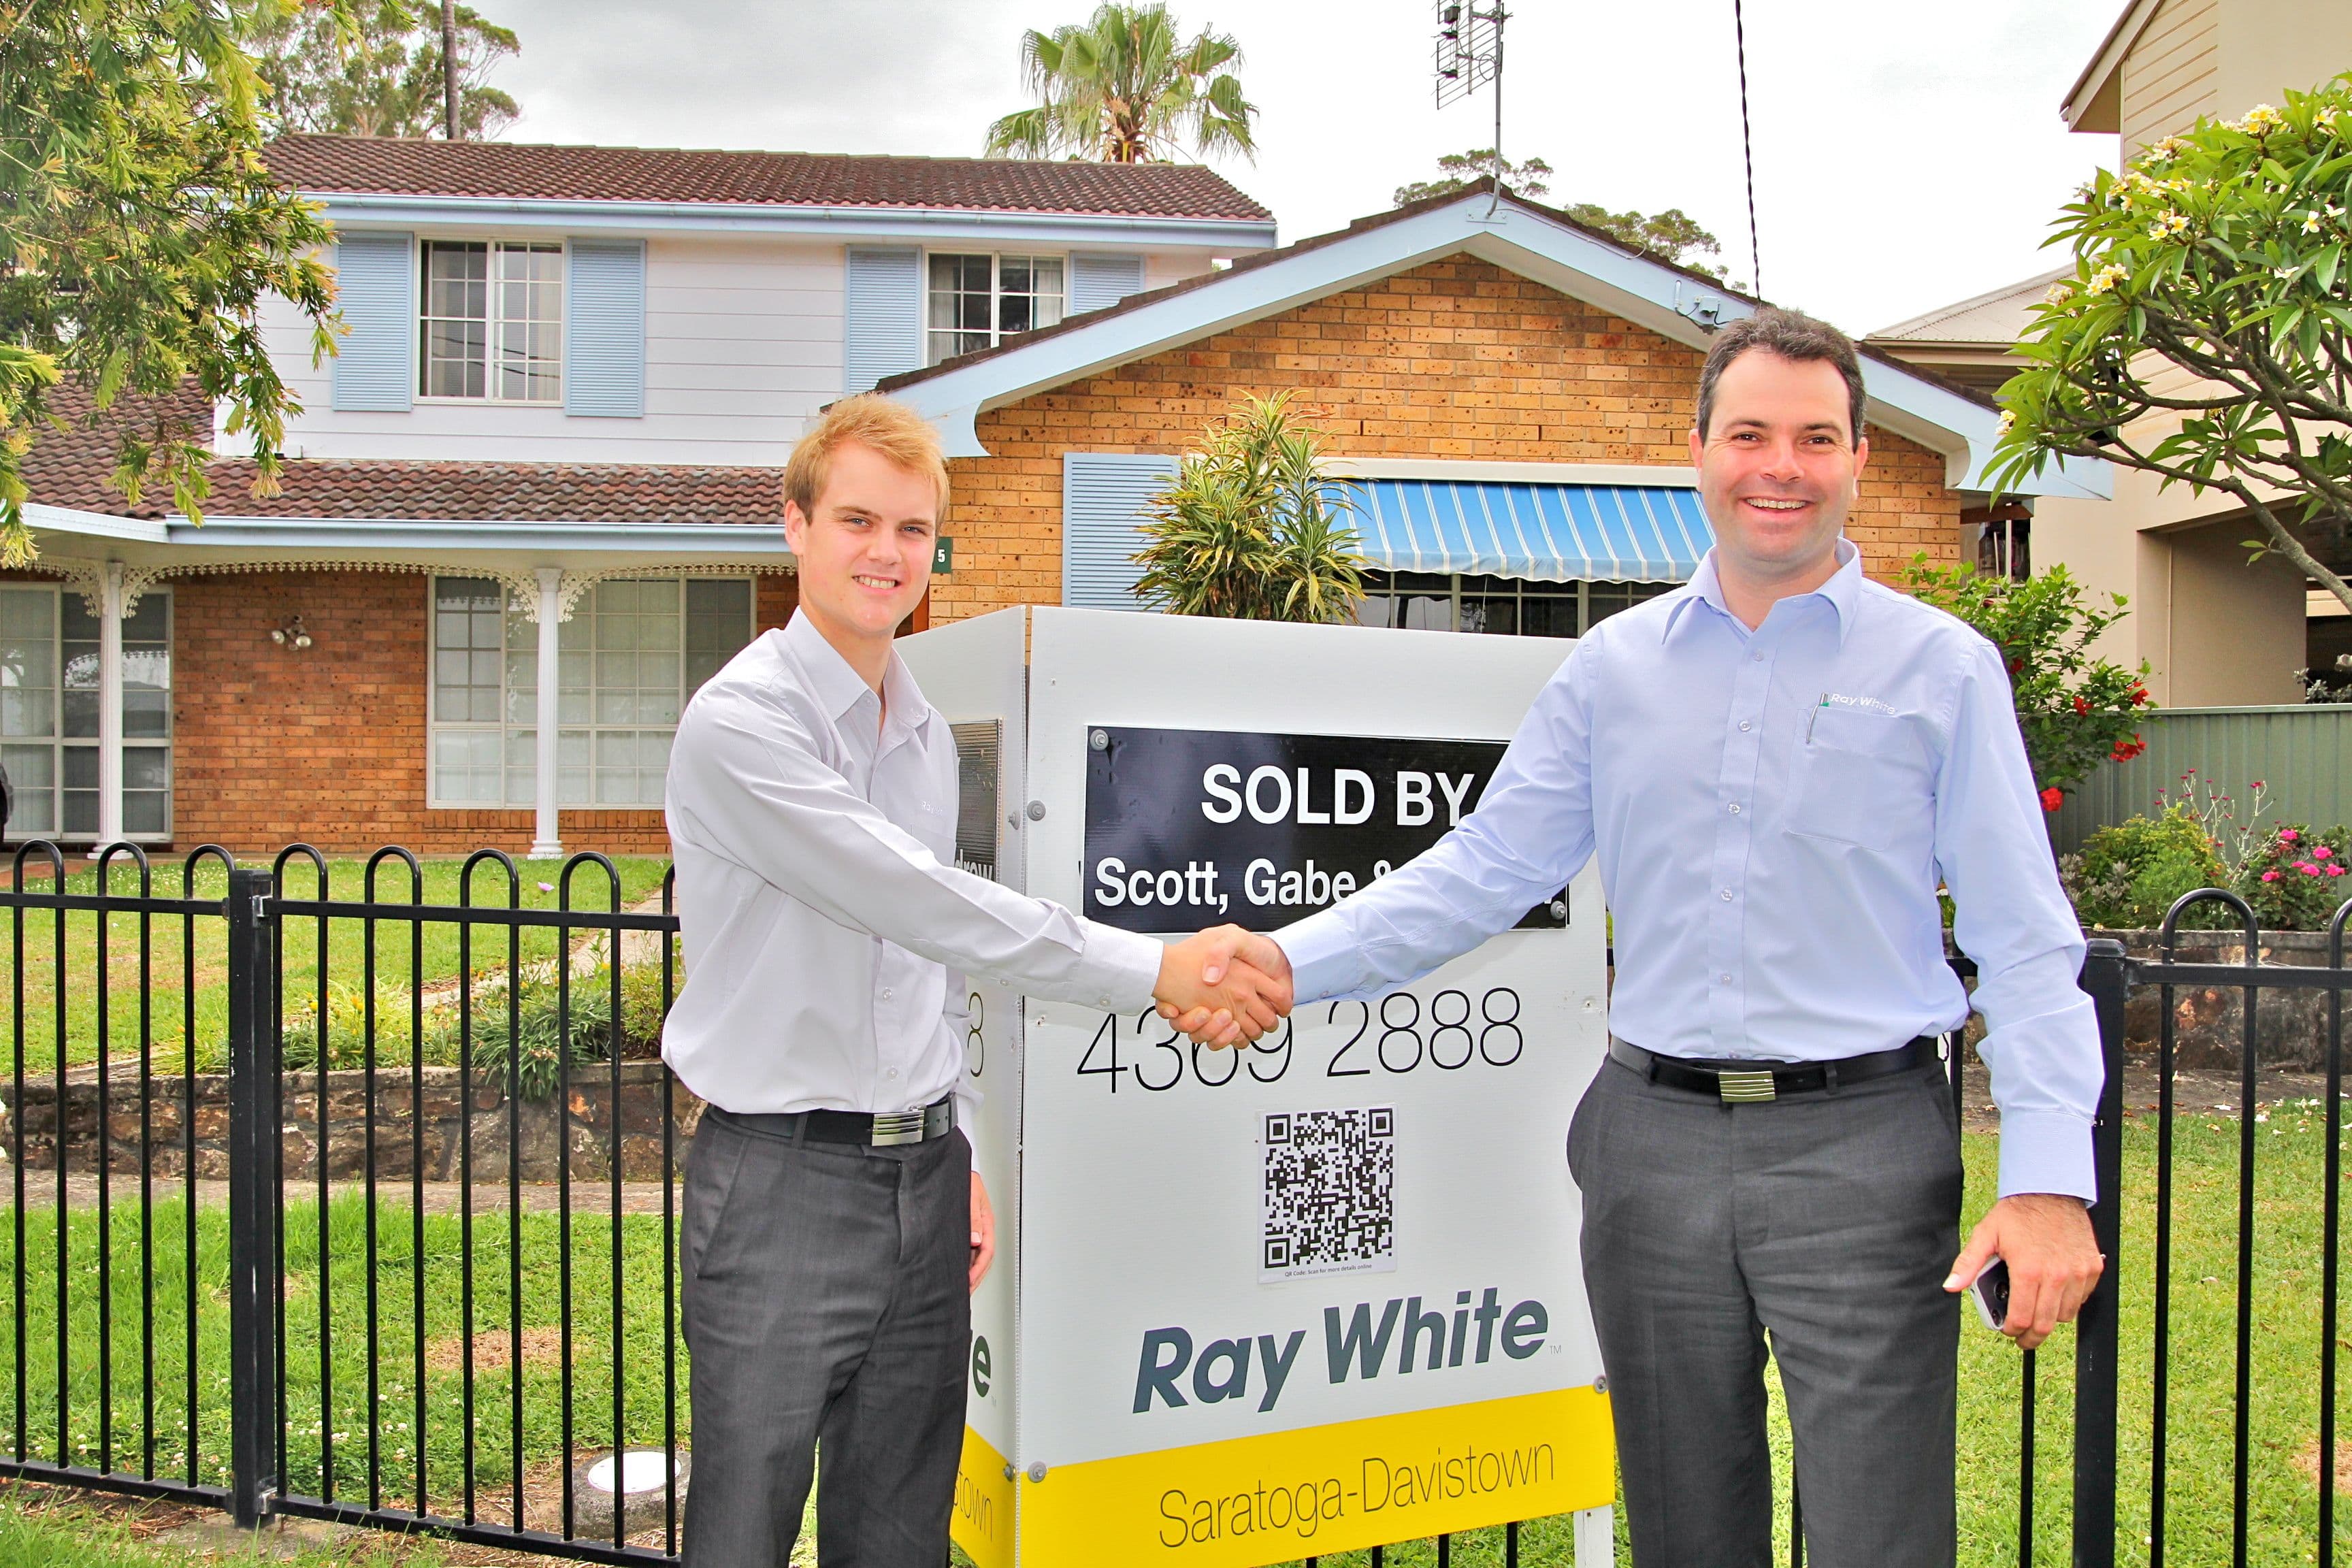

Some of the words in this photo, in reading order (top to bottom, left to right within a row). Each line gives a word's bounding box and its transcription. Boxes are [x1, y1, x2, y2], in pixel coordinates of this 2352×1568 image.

[938, 549, 945, 563] 5
[1830, 693, 1858, 706] Ray
[1860, 697, 1896, 715] White
[1200, 763, 1375, 825] SOLD
[1396, 770, 1475, 826] BY
[1094, 857, 1228, 915] Scott,
[1244, 858, 1356, 906] Gabe
[1326, 987, 1523, 1077] 2888
[1132, 1326, 1307, 1414] Ray
[1324, 1287, 1548, 1384] White
[1159, 1443, 1554, 1548] Saratoga-Davistown
